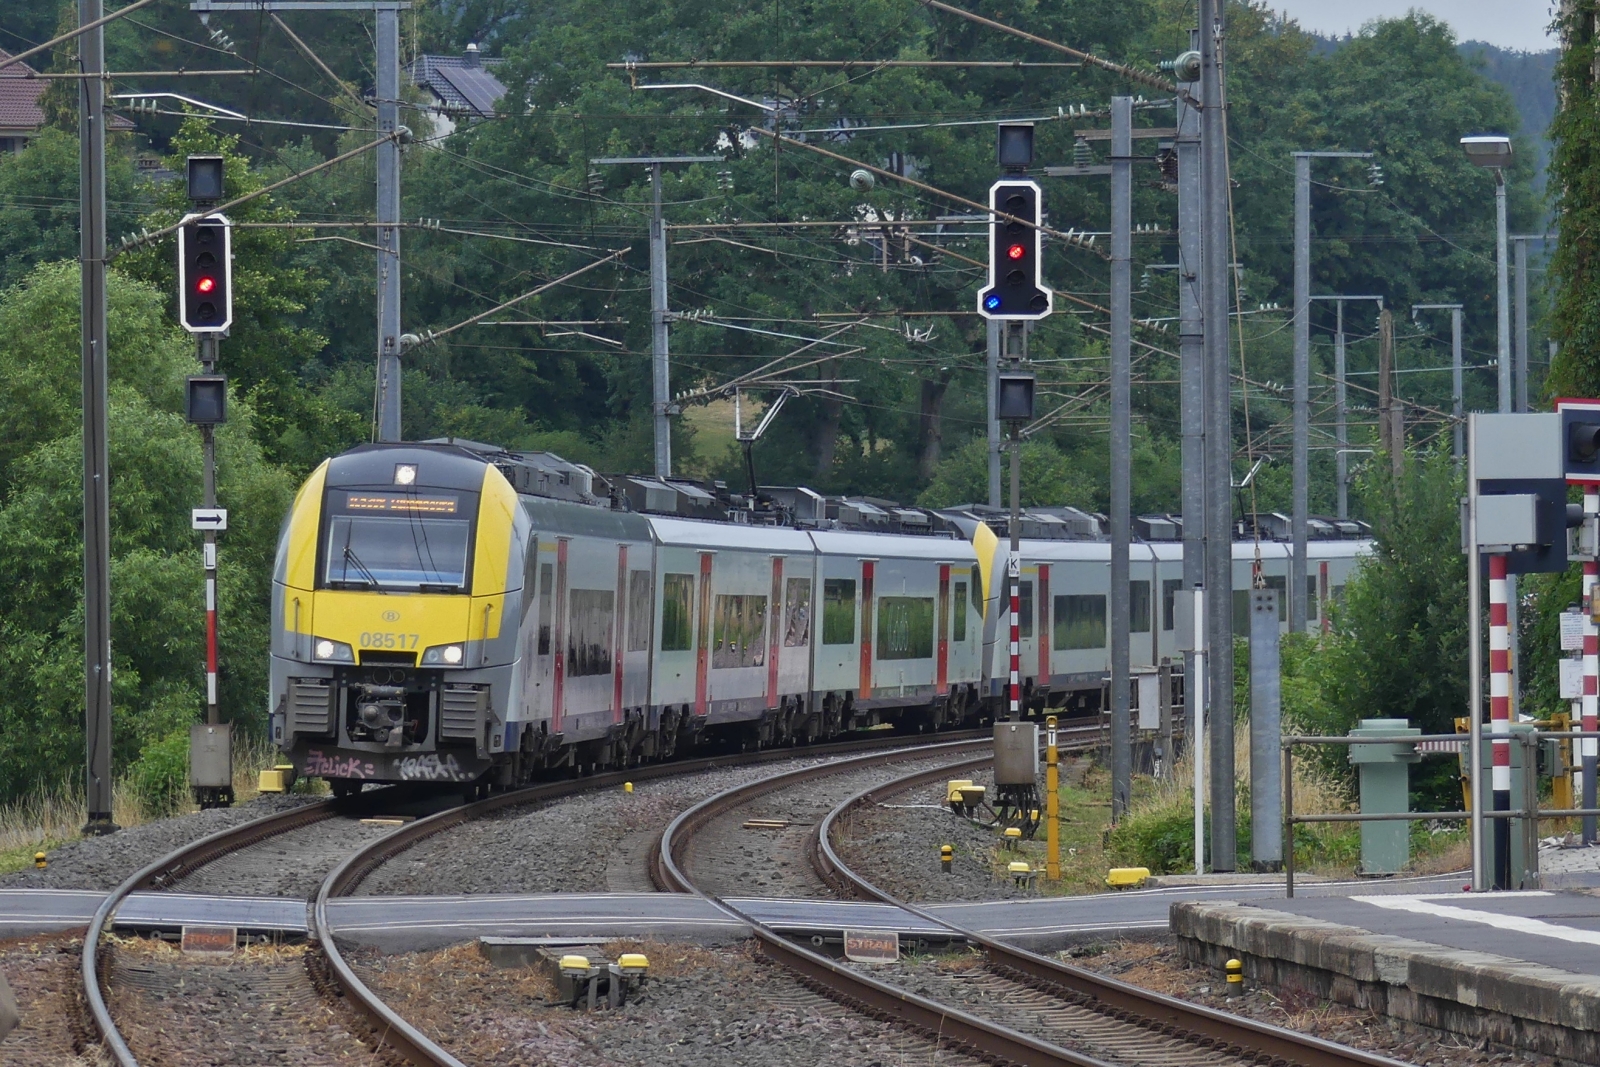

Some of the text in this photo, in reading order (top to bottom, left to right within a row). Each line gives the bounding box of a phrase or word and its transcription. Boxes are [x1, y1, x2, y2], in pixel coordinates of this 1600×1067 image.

[1010, 558, 1018, 569] K
[360, 632, 420, 649] 08517
[1048, 731, 1055, 744] T
[847, 937, 898, 951] STRAIL
